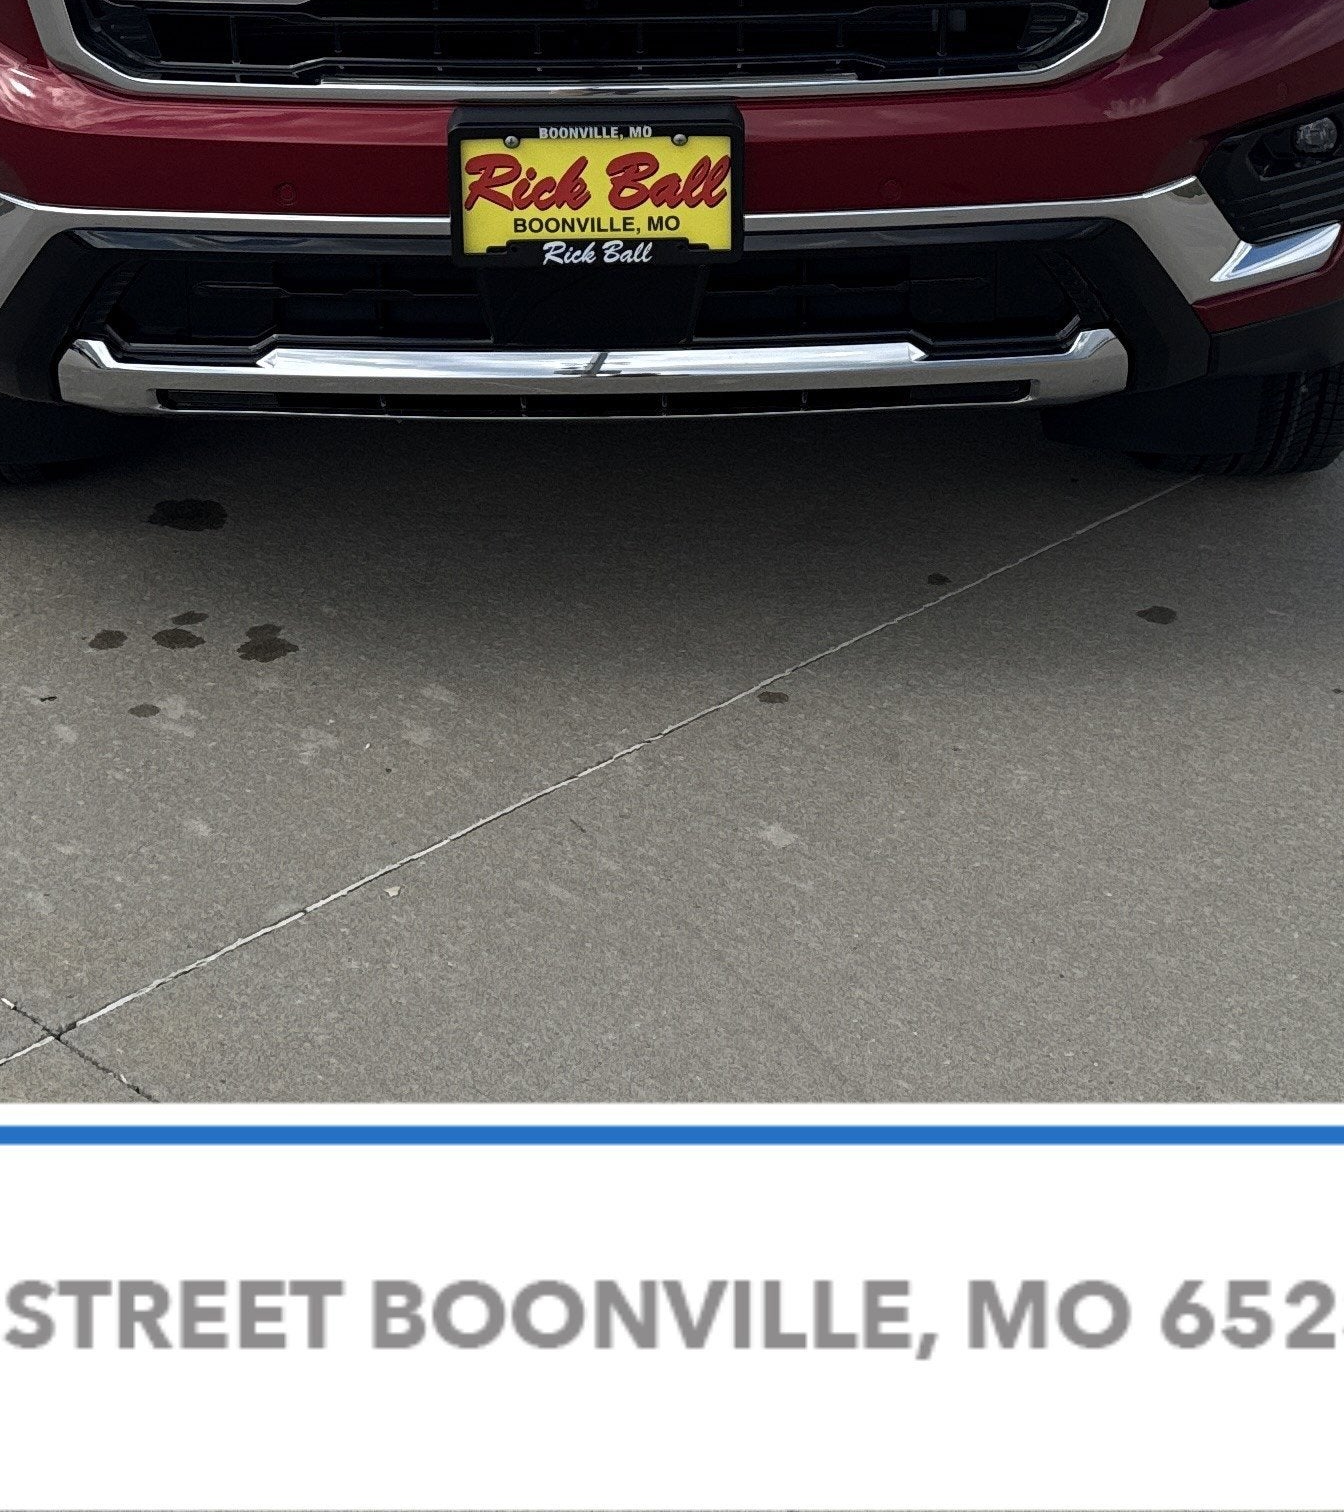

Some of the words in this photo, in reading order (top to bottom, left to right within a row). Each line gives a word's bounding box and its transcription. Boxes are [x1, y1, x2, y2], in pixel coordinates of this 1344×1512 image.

[539, 125, 624, 141] BOONVILLE,
[628, 125, 653, 139] MO
[463, 152, 592, 212] Rick
[605, 150, 731, 211] Ball
[513, 216, 641, 235] BOONVILLE,
[647, 215, 681, 232] MO
[542, 241, 596, 266] Rick
[602, 240, 653, 265] Ball
